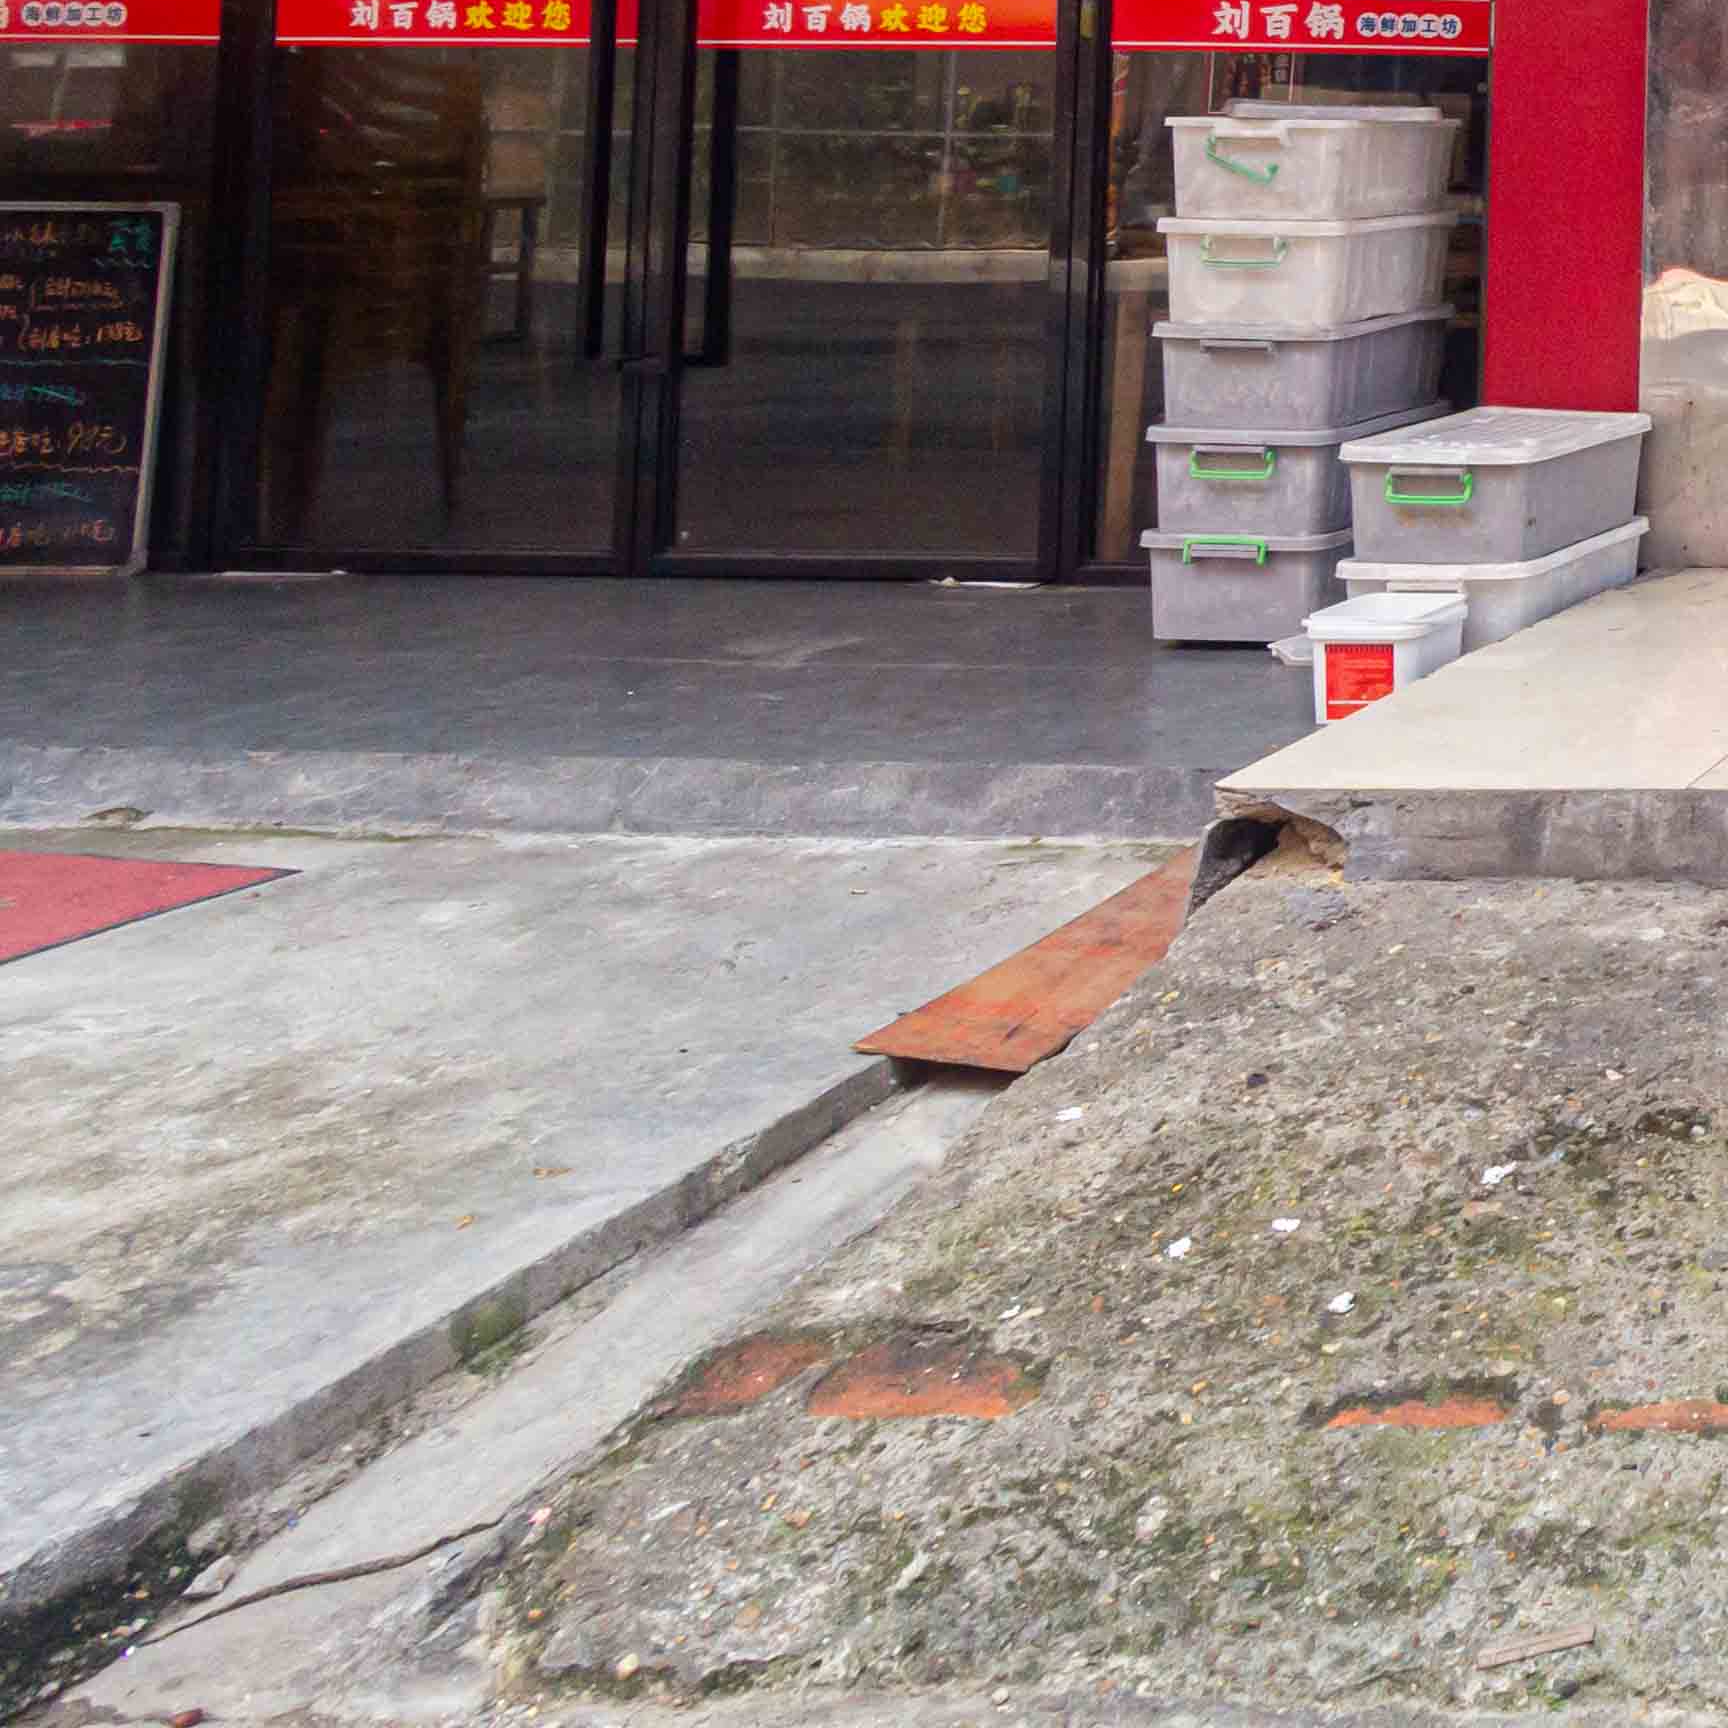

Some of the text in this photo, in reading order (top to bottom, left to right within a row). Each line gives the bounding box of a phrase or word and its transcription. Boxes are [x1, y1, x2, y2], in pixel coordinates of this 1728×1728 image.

[349, 0, 572, 31] 刘百锅欢迎您
[762, 0, 988, 33] 刘百锅欢迎您
[1210, 1, 1461, 40] 刘百锅 海鲜加工坊
